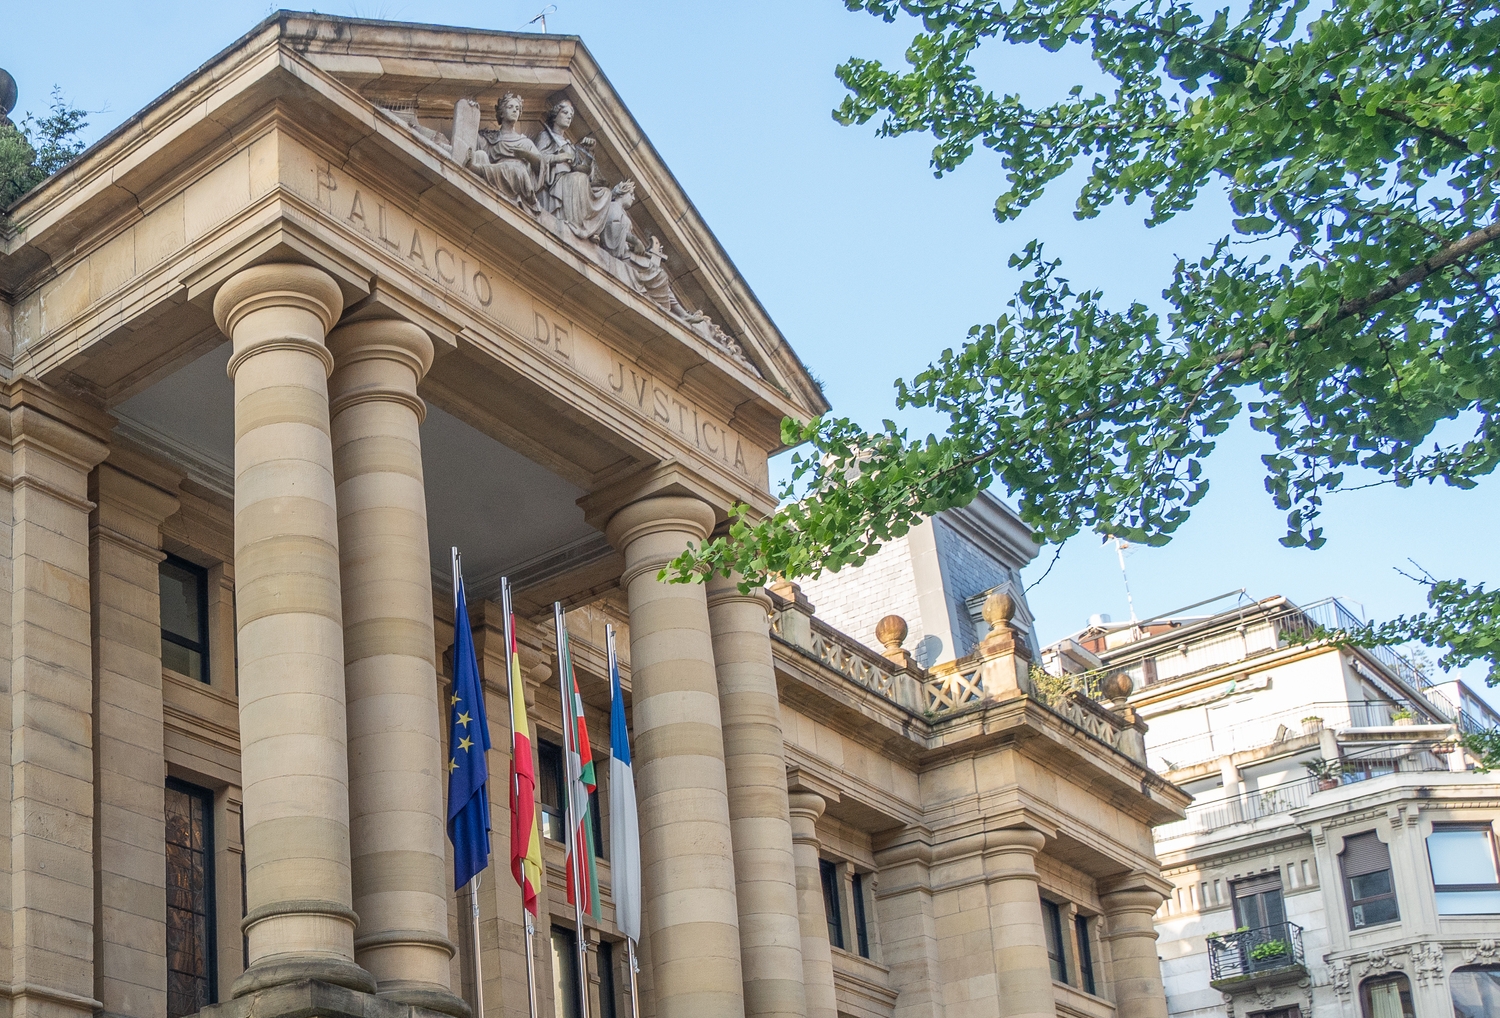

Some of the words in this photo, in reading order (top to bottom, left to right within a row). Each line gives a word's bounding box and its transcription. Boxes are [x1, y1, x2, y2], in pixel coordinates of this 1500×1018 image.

[315, 163, 493, 307] PALACIO
[532, 310, 570, 360] DE
[608, 362, 748, 475] JVSTICIA
